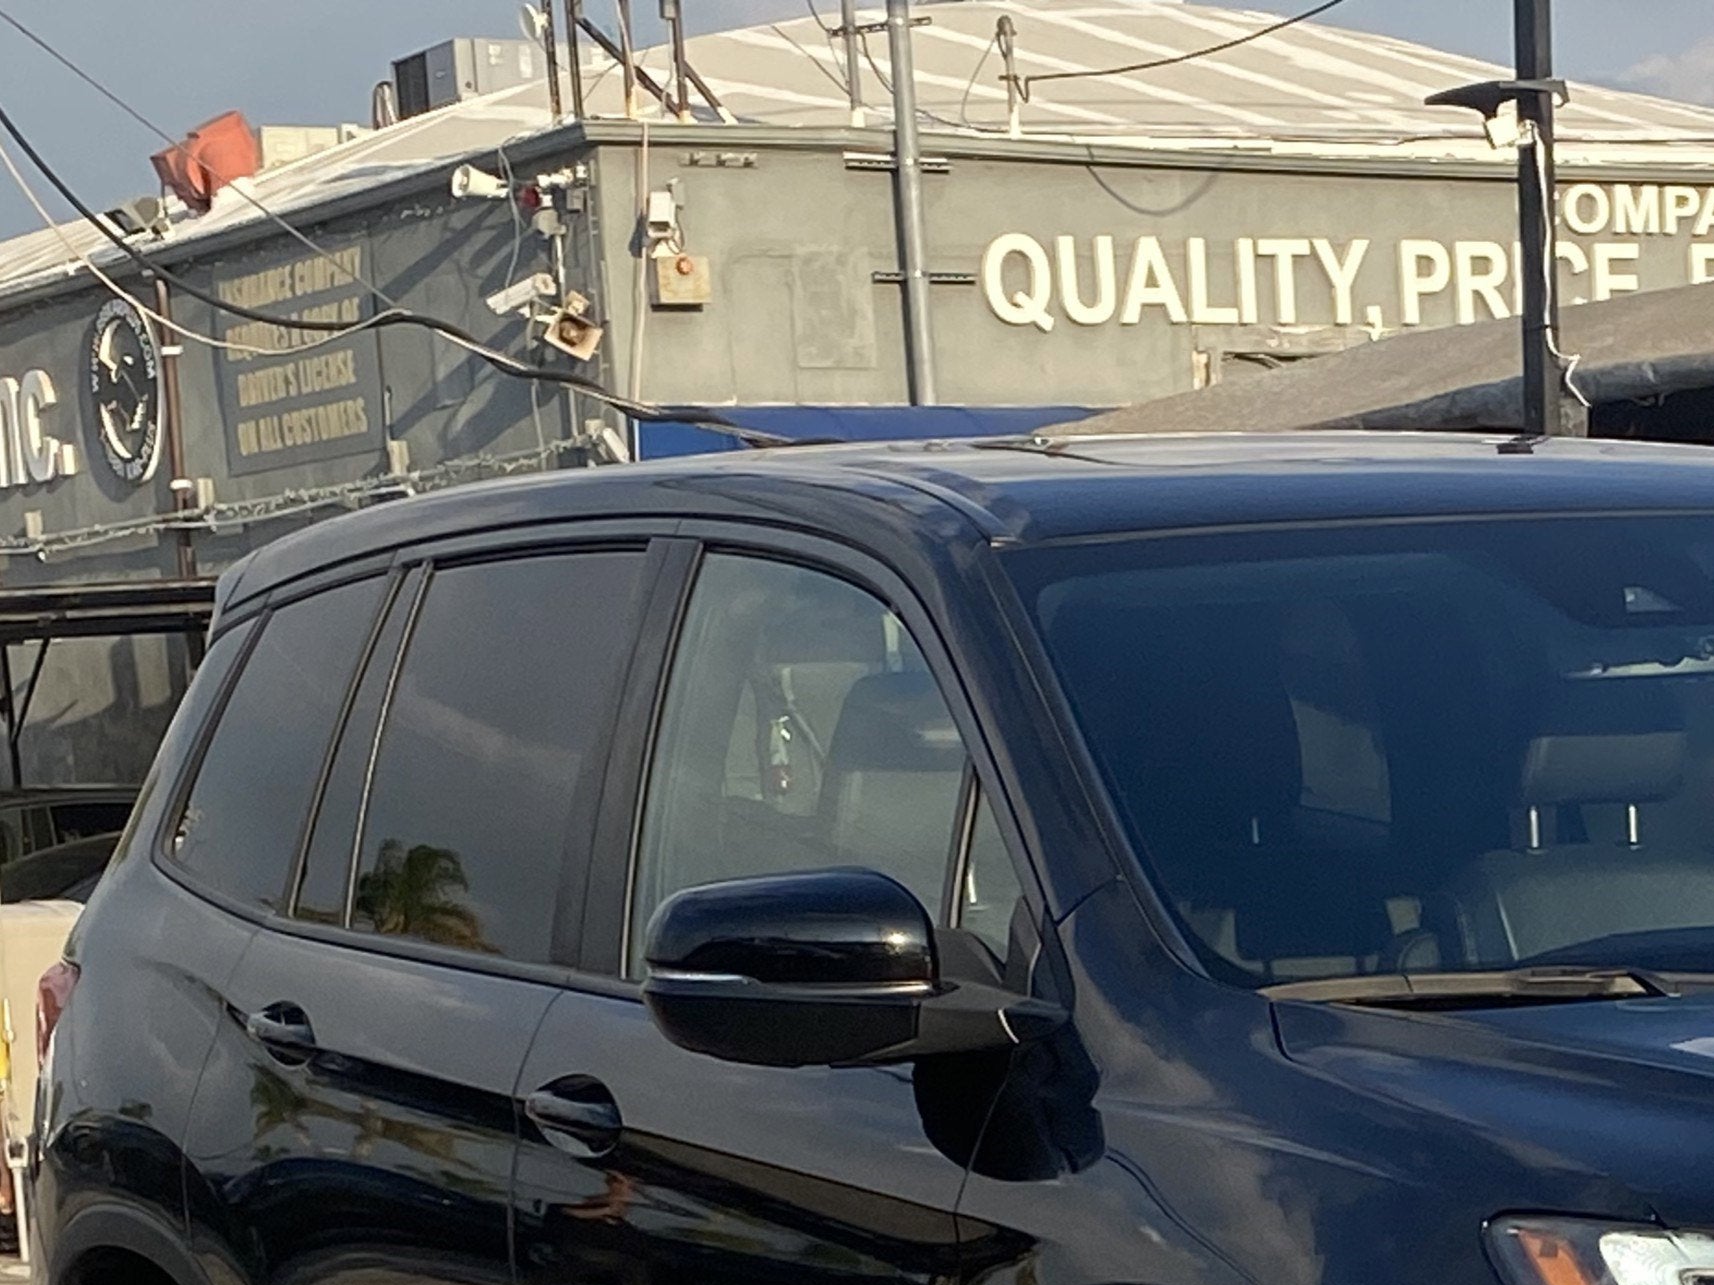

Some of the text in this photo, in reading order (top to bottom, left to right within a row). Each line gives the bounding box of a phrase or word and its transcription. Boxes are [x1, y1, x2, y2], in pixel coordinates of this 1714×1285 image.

[219, 247, 361, 314] INSURANCE COMPANY
[981, 232, 1384, 342] QUALITY,
[226, 314, 289, 361] REQUIRES
[302, 301, 341, 345] COPY
[340, 297, 361, 330] OF
[238, 349, 357, 408] DRIVER'S LICENSE
[238, 397, 368, 456] ON ALL CUSTOMERS
